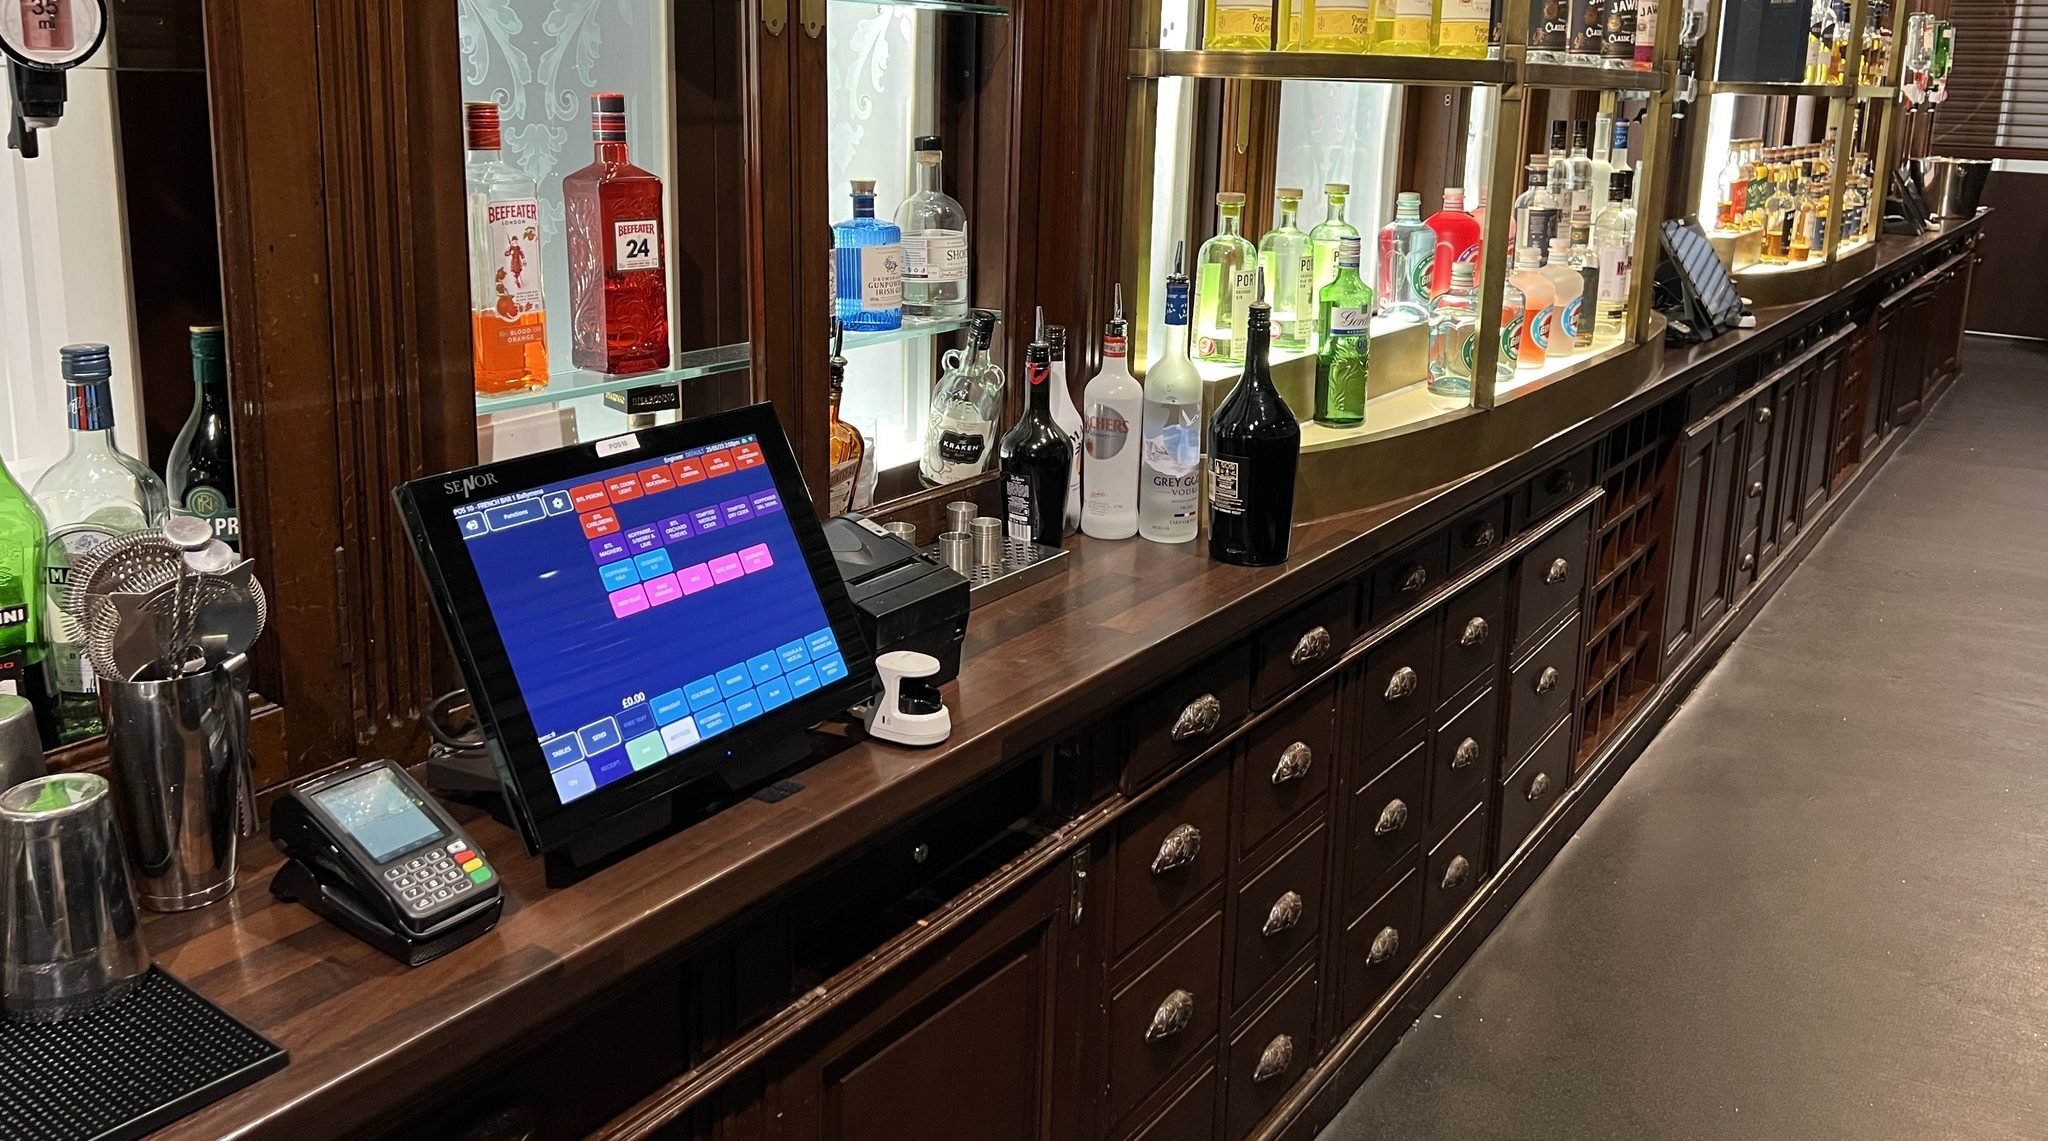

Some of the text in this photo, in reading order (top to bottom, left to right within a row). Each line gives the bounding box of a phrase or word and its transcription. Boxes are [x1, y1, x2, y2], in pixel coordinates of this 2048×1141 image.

[488, 204, 537, 224] BEEFEATER
[618, 223, 655, 237] BEEFEATER
[626, 238, 650, 259] 24
[510, 327, 532, 335] BLOOD
[507, 334, 535, 343] ORANGE
[943, 440, 979, 451] KRAKEN
[444, 472, 499, 498] SENOR
[1153, 476, 1181, 487] GREY
[453, 507, 466, 516] POS
[466, 505, 474, 513] 10
[477, 498, 500, 510] FRENCH
[500, 495, 512, 504] BAR
[503, 509, 529, 520] Functions
[215, 517, 240, 536] PR
[621, 692, 646, 709] £0.00
[551, 745, 572, 758] TABLES
[431, 851, 440, 859] 3
[409, 888, 417, 896] 7
[438, 889, 447, 897] 0
